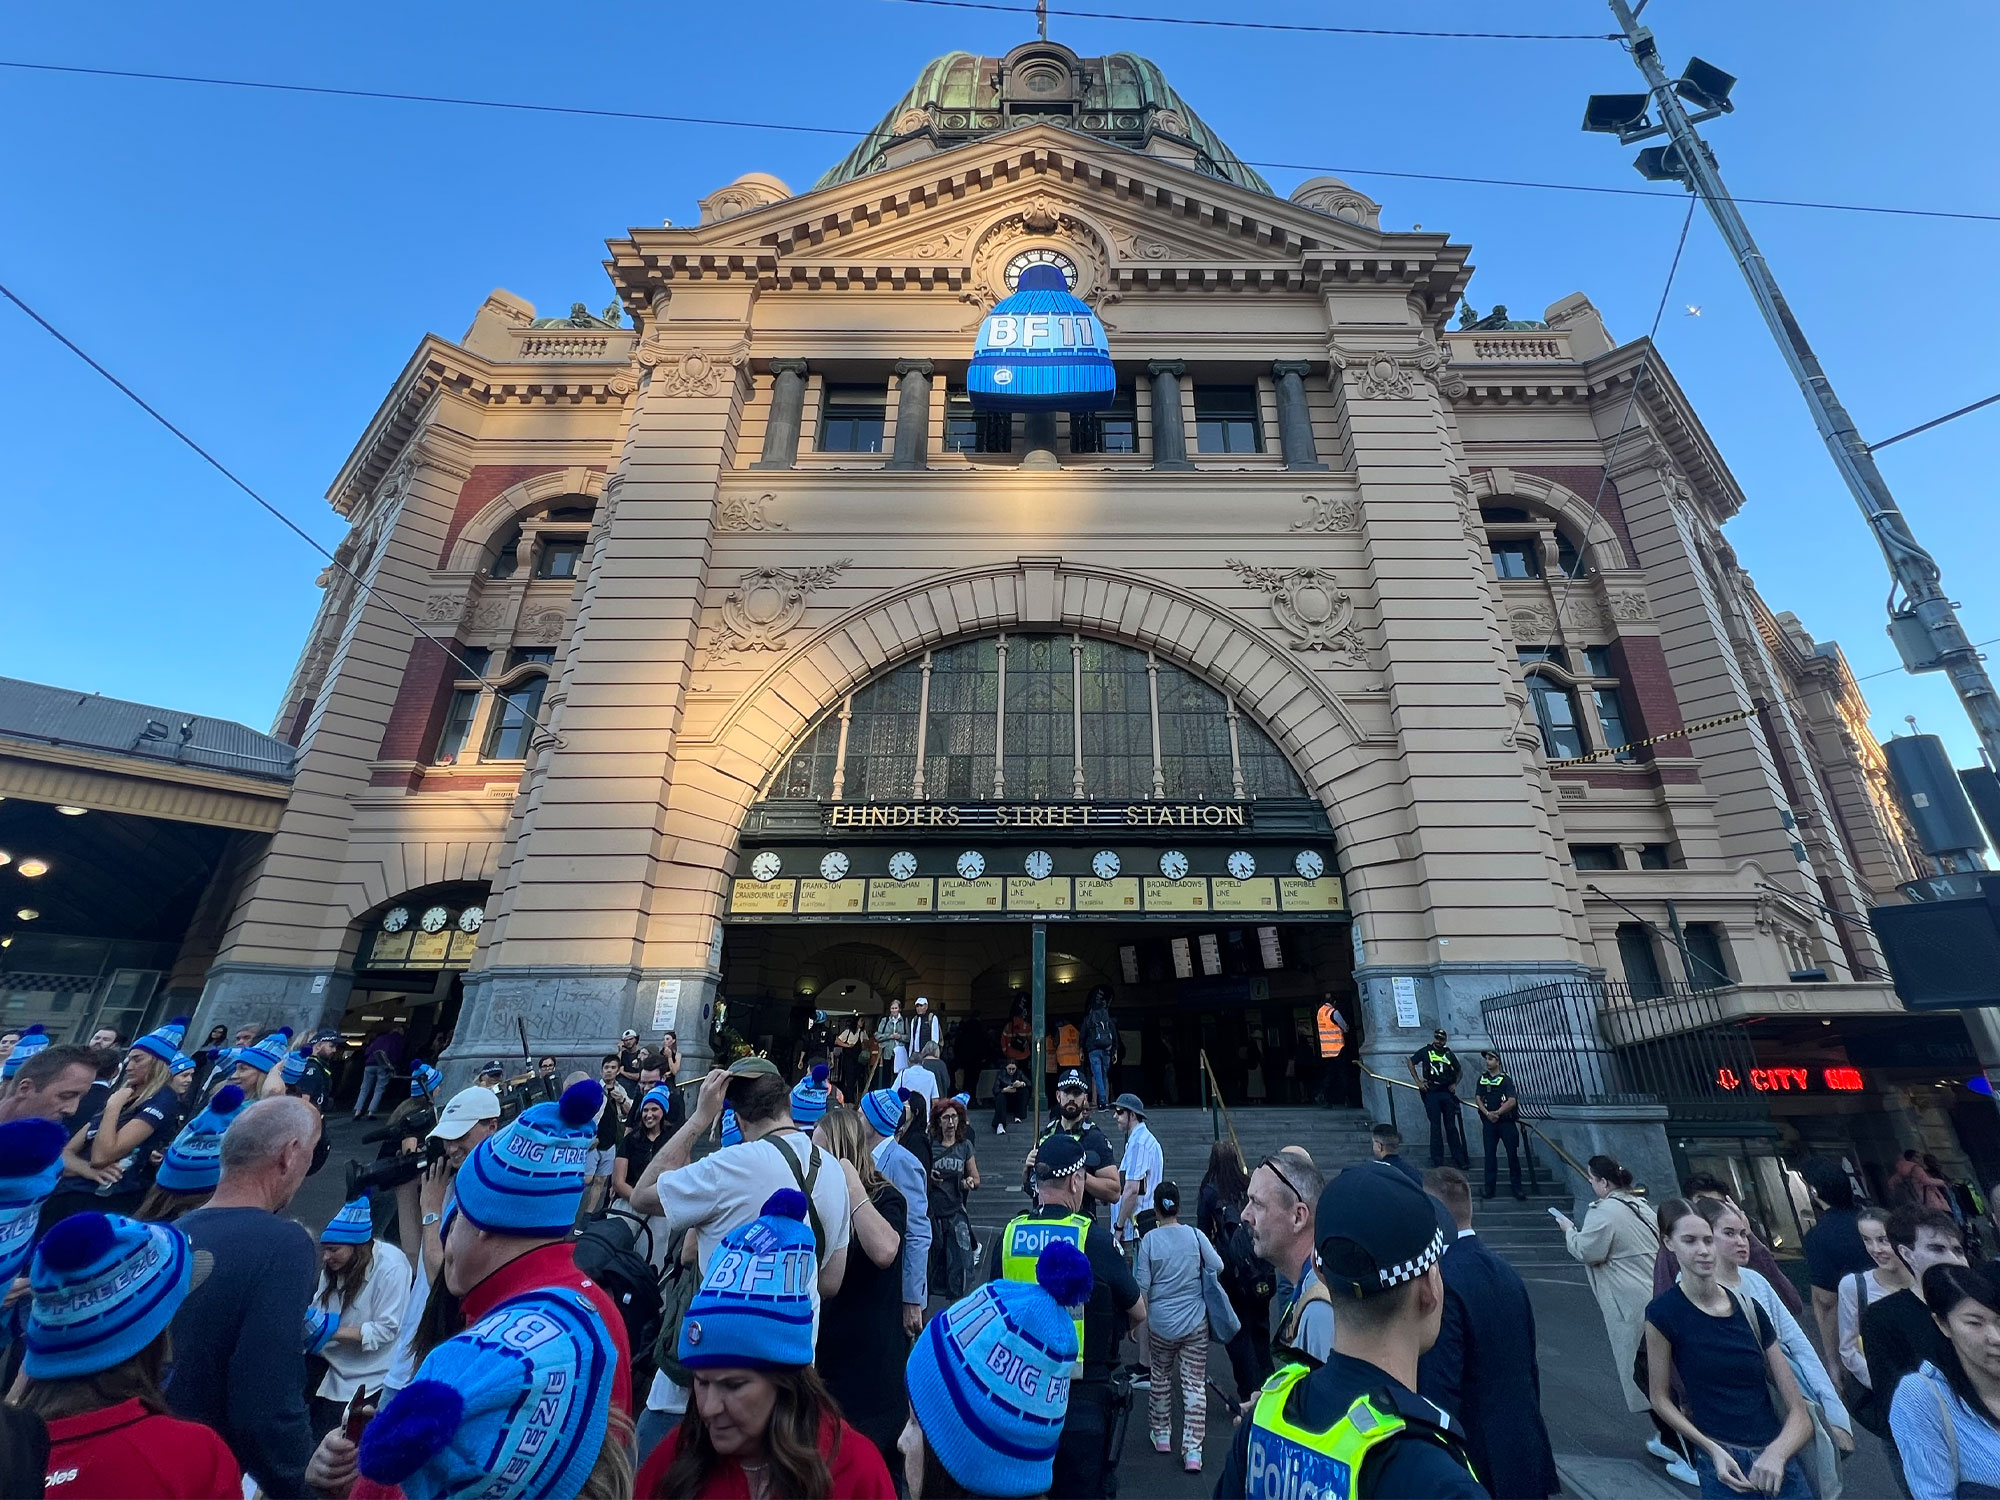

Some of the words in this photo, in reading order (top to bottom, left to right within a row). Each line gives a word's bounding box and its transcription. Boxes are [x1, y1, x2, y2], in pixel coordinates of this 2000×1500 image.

[832, 806, 960, 826] FLINDERS
[996, 806, 1092, 826] STREET
[1127, 805, 1245, 826] STATION
[736, 882, 768, 890] PAKENHAM
[770, 882, 781, 890] and
[872, 881, 920, 889] SANDRINGHAM
[1079, 880, 1088, 888] ST
[1088, 880, 1114, 888] ALBANS
[1146, 880, 1202, 888] BROADMEADOWS
[1215, 880, 1242, 888] UPFIELD
[734, 891, 775, 899] CRANBOURNE
[801, 891, 816, 899] LINE
[871, 890, 886, 898] LINE
[1010, 889, 1024, 897] LINE
[1079, 889, 1093, 897] LINE
[1216, 889, 1230, 897] LINE
[1750, 1069, 1807, 1091] CITY
[507, 1131, 547, 1162] BIG
[986, 1341, 1041, 1397] BIG
